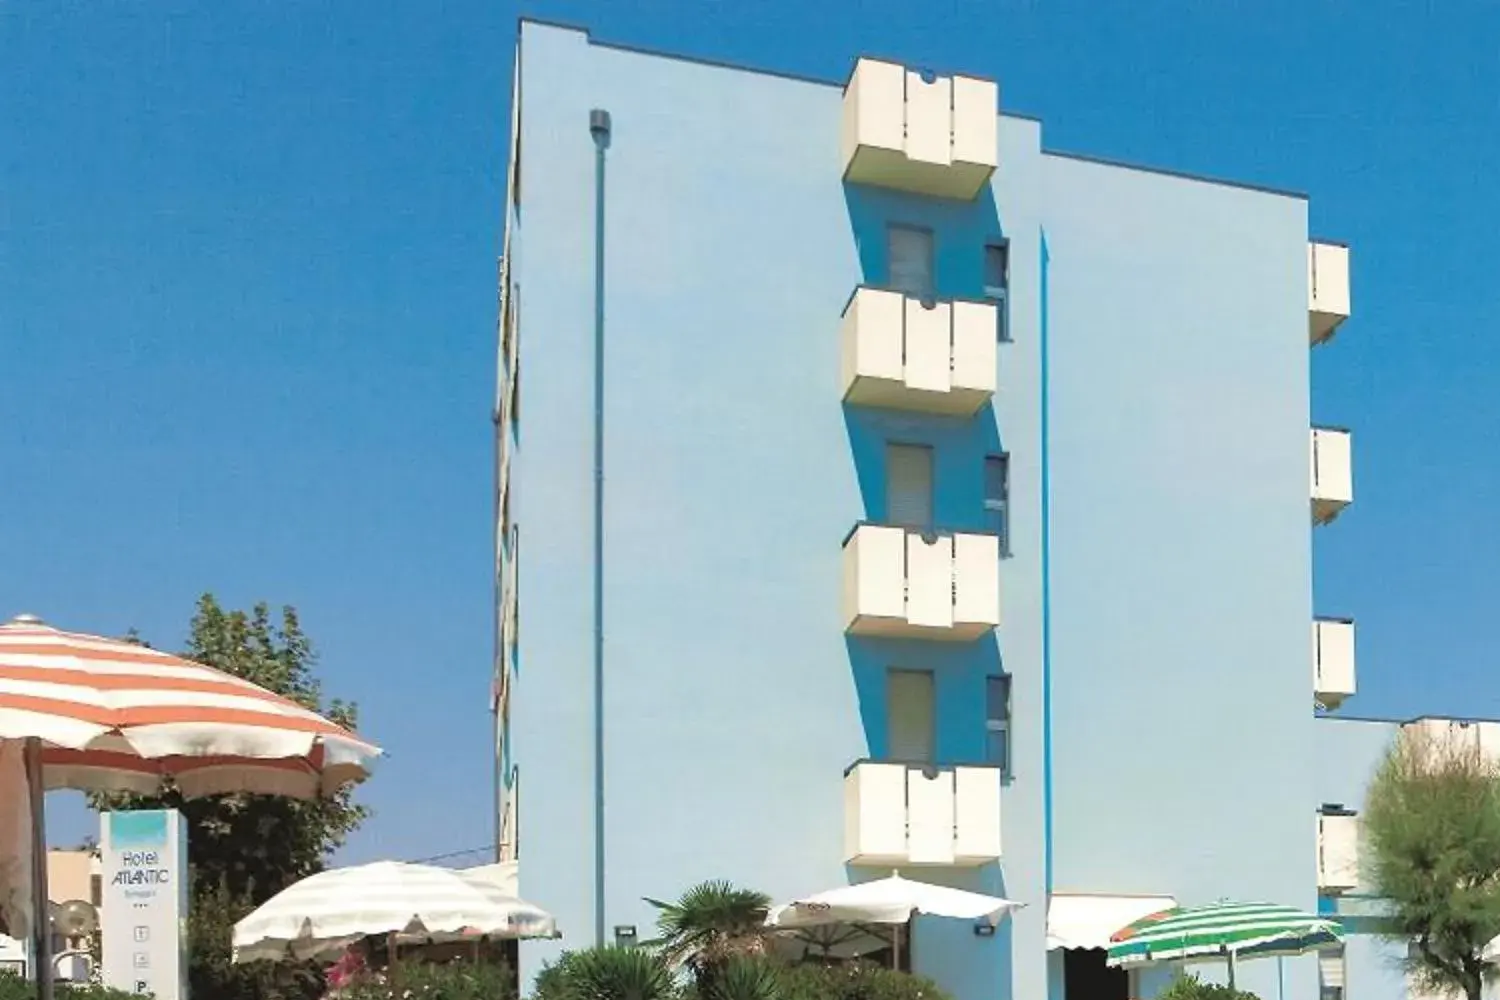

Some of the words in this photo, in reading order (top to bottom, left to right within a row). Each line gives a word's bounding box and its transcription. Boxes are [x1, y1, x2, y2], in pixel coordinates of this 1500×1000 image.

[122, 851, 159, 866] Hotel
[111, 869, 169, 885] ATLANTIC
[137, 981, 147, 993] P
